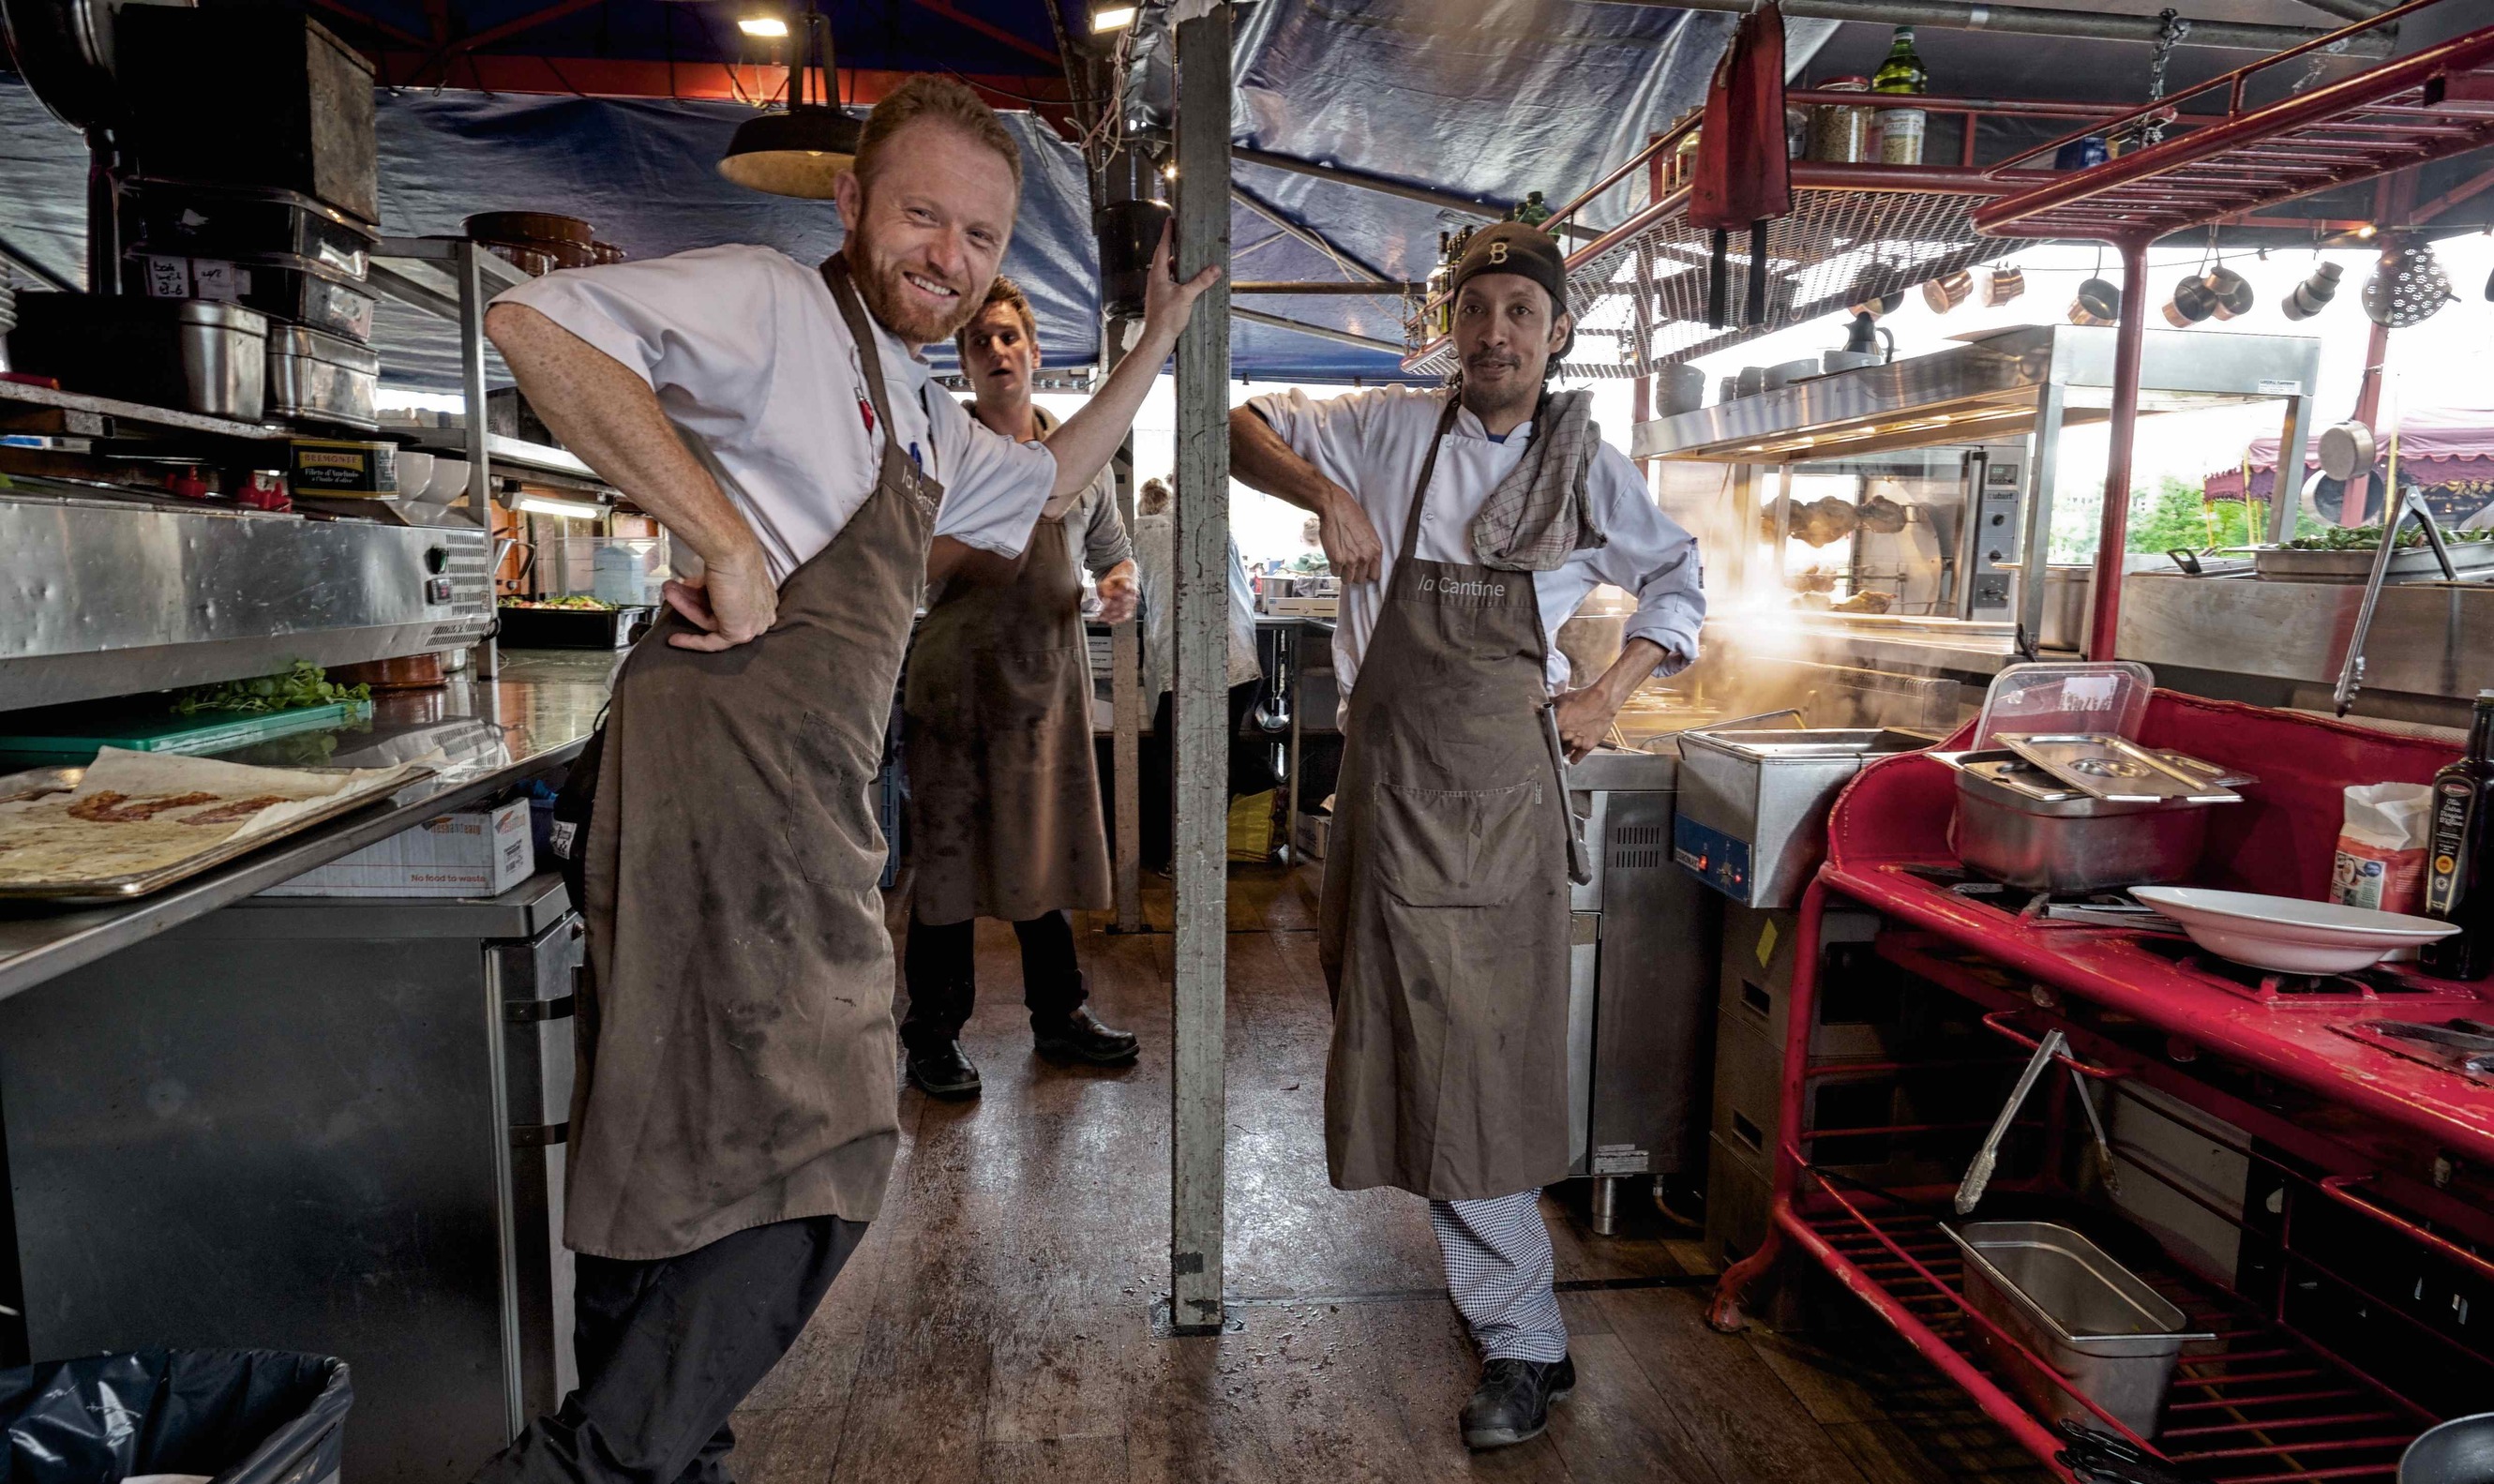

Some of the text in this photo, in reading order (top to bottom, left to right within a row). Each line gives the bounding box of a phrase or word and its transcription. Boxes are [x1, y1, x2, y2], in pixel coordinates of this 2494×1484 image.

[1487, 242, 1510, 265] B
[901, 465, 913, 489] la
[1418, 574, 1505, 596] la Cantine
[411, 874, 423, 883] No
[426, 874, 446, 883] food
[448, 875, 458, 883] to
